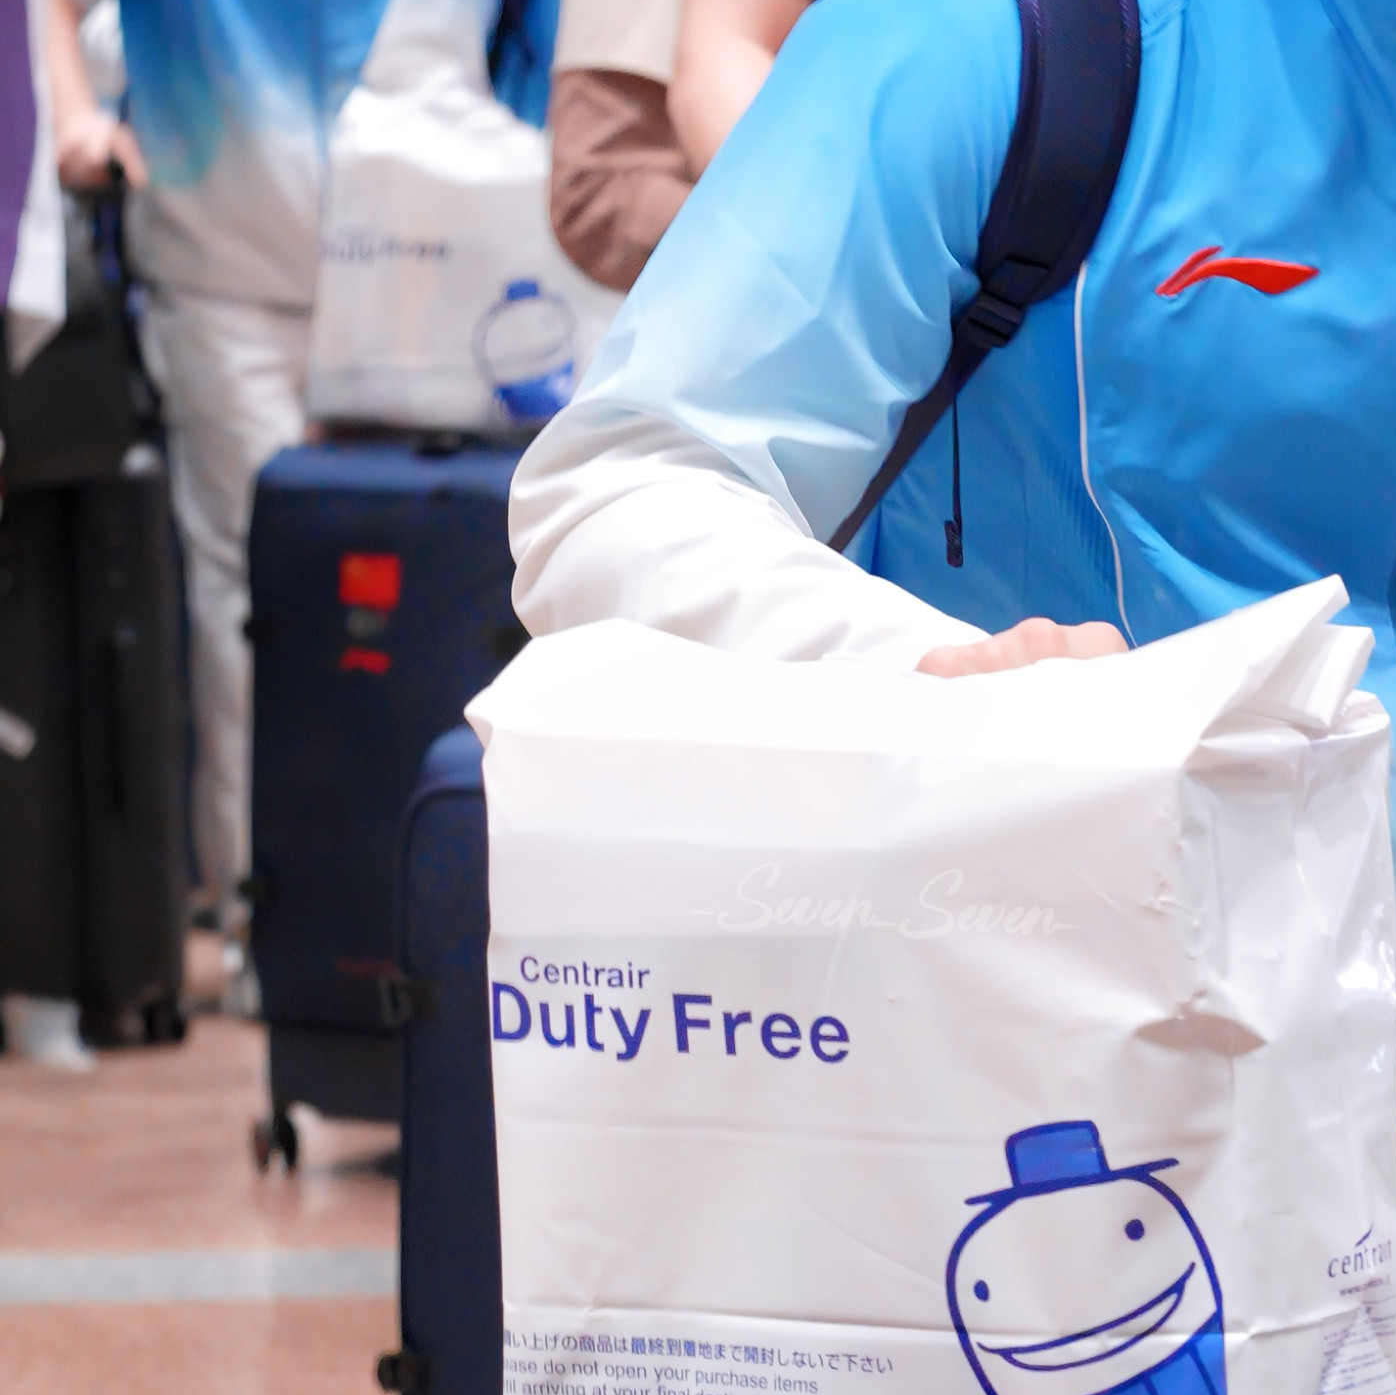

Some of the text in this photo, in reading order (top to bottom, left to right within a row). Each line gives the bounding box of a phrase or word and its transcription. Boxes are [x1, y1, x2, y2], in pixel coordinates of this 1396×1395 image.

[520, 956, 650, 989] Centrair
[491, 980, 850, 1064] Duty Free
[543, 1359, 567, 1375] do
[571, 1361, 599, 1377] not
[604, 1364, 647, 1381] open
[653, 1367, 691, 1383] your
[694, 1370, 768, 1390] purchase
[773, 1373, 818, 1394] items
